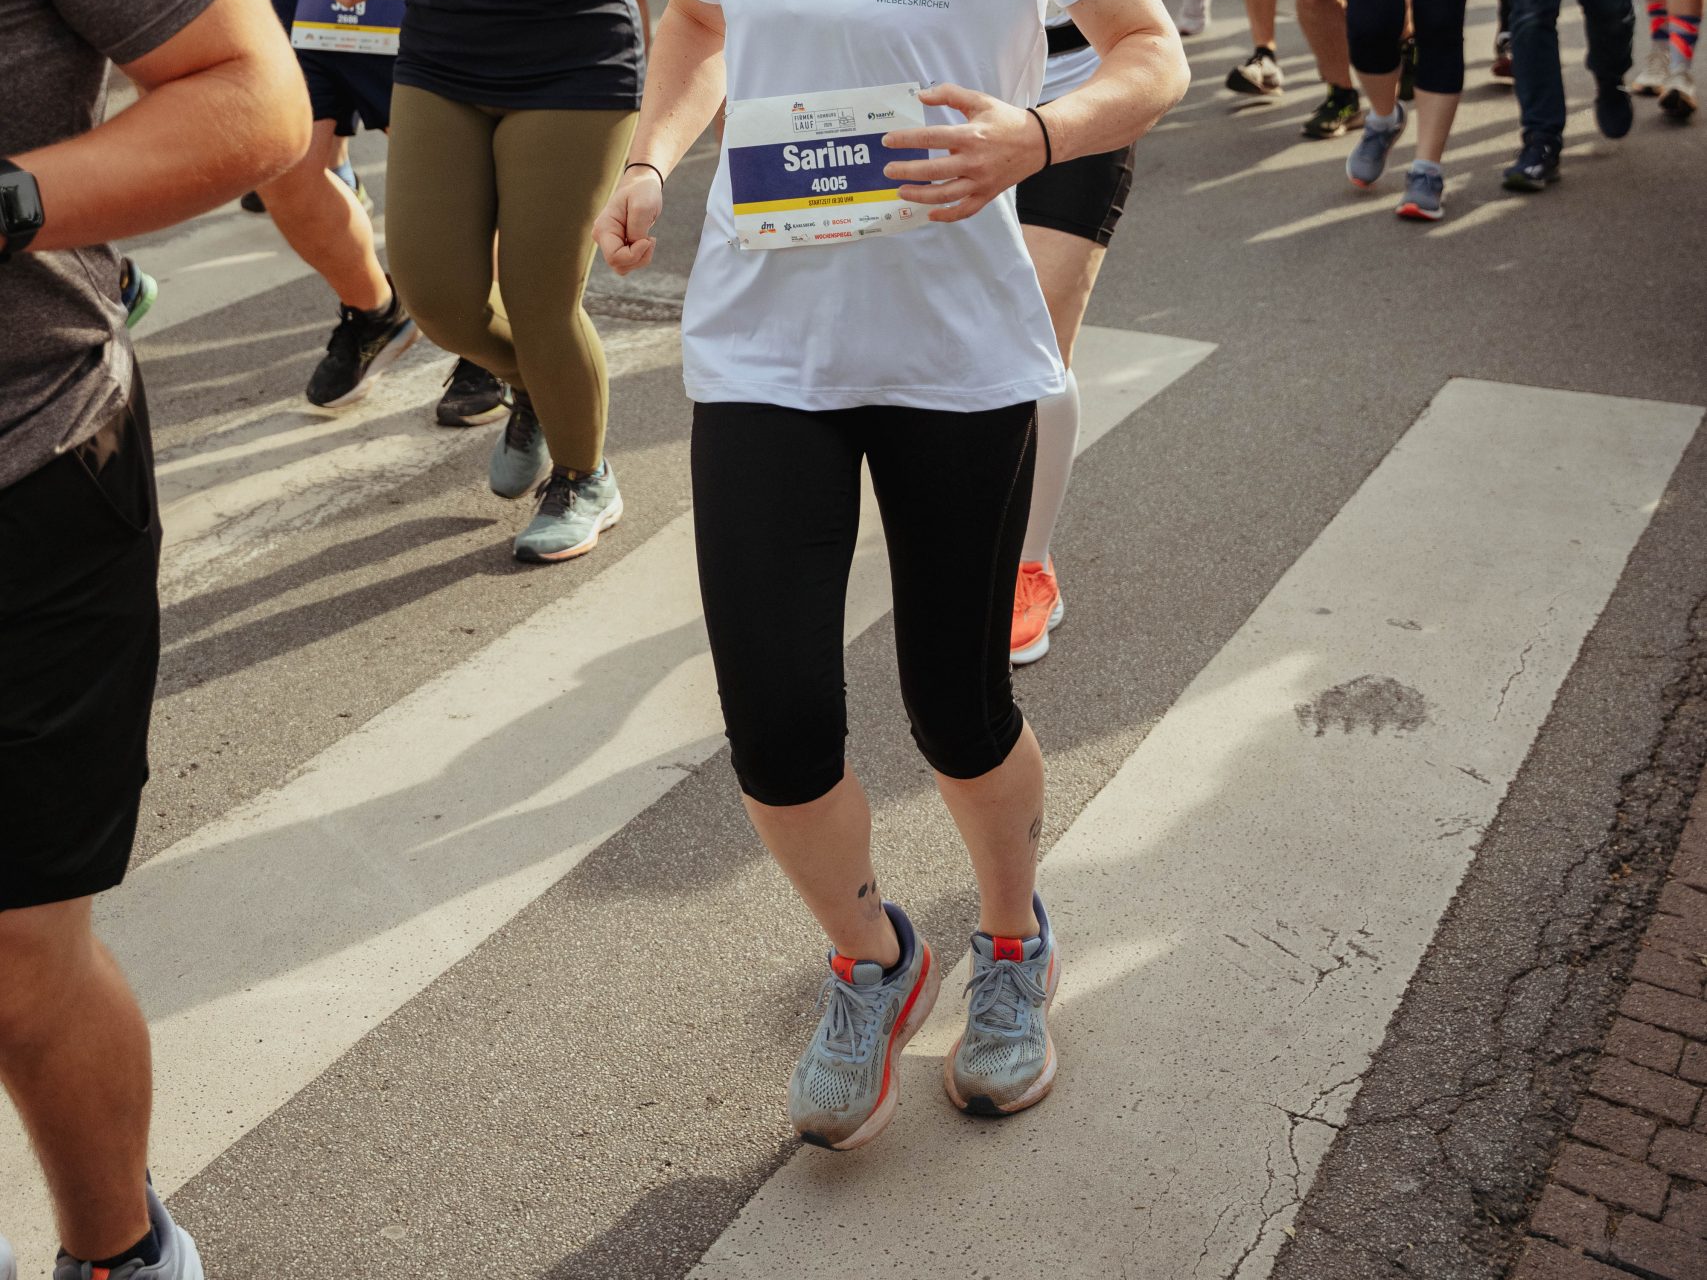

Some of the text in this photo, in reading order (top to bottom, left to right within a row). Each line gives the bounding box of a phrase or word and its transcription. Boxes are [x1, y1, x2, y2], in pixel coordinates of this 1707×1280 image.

[795, 120, 814, 131] LAUF
[783, 141, 870, 172] Sarina
[811, 176, 848, 193] 4005
[761, 221, 775, 230] dm
[831, 218, 852, 226] BOSCH
[814, 230, 852, 240] WOCHENSPIEGEL
